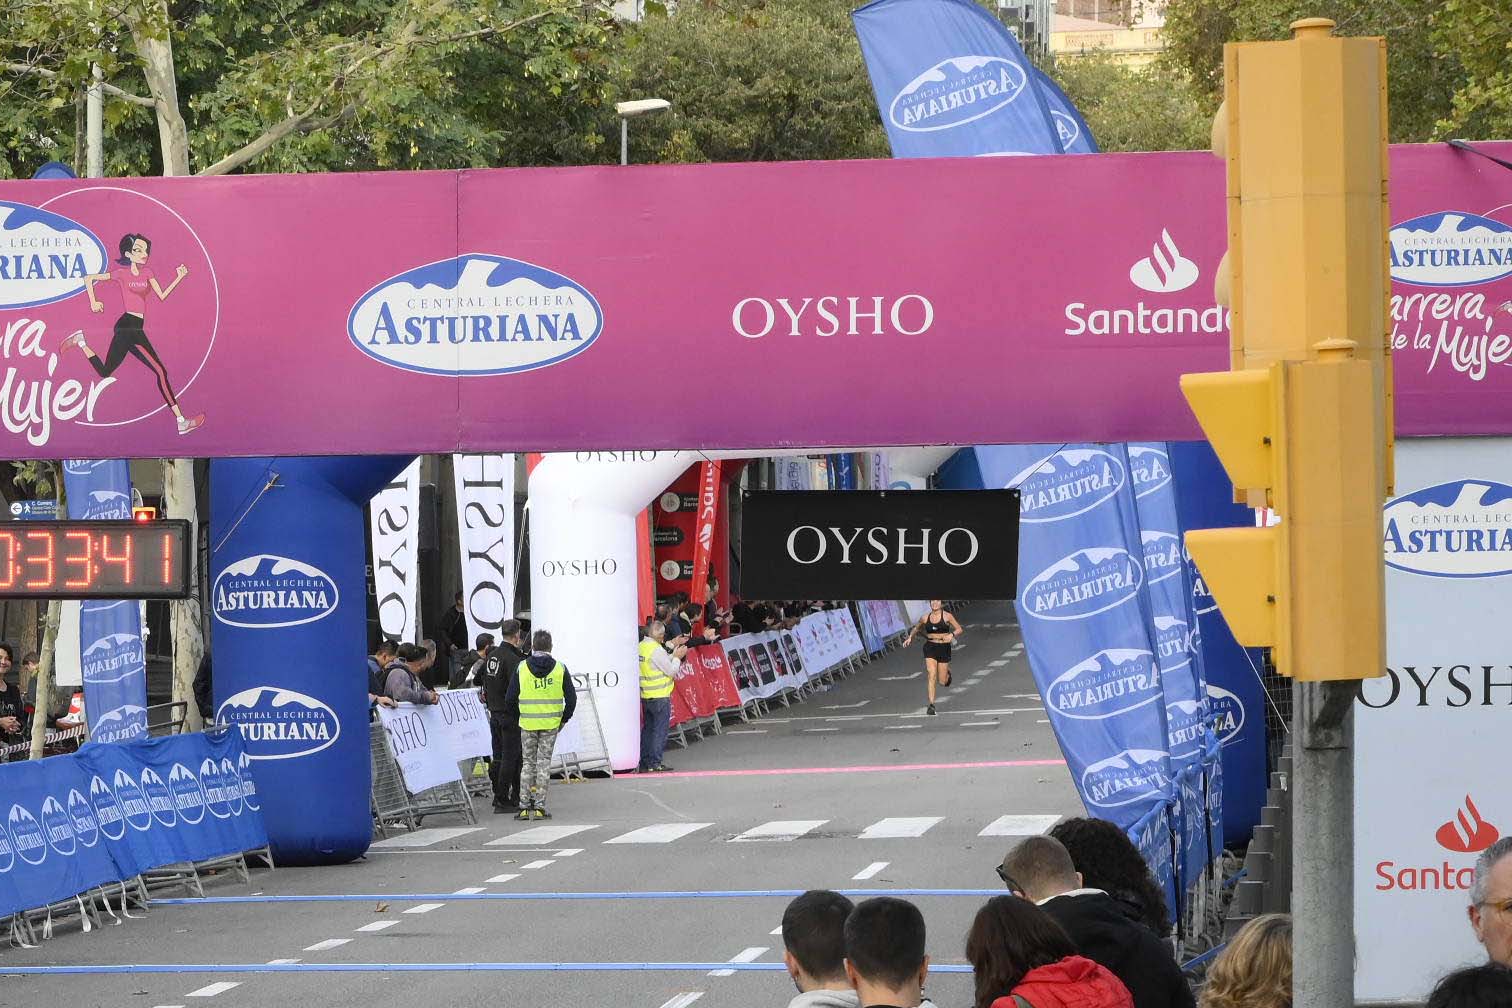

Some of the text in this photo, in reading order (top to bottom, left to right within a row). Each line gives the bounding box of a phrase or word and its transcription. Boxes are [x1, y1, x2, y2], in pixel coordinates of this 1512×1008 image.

[10, 236, 82, 248] LECHERA
[1404, 237, 1456, 246] CENTRAL
[407, 294, 575, 309] CENTRAL LECHERA
[1390, 292, 1487, 322] arrera
[368, 301, 583, 345] ASTURIANA
[731, 294, 934, 339] OYSHO
[1064, 301, 1234, 336] Santand
[1413, 321, 1431, 349] la
[1427, 315, 1512, 381] Muje
[1410, 513, 1478, 525] CENTRAL
[786, 525, 979, 567] OYSHO
[541, 558, 617, 577] OYSHO
[229, 579, 325, 588] CENTRAL LECHERA
[216, 584, 330, 612] ASTURIANA
[534, 676, 553, 690] Life
[573, 670, 619, 688] SHO
[1357, 664, 1512, 709] OYSH
[230, 711, 325, 720] CENTRAL LECHERA
[238, 722, 330, 741] TURIANA
[1375, 861, 1475, 891] Santa
